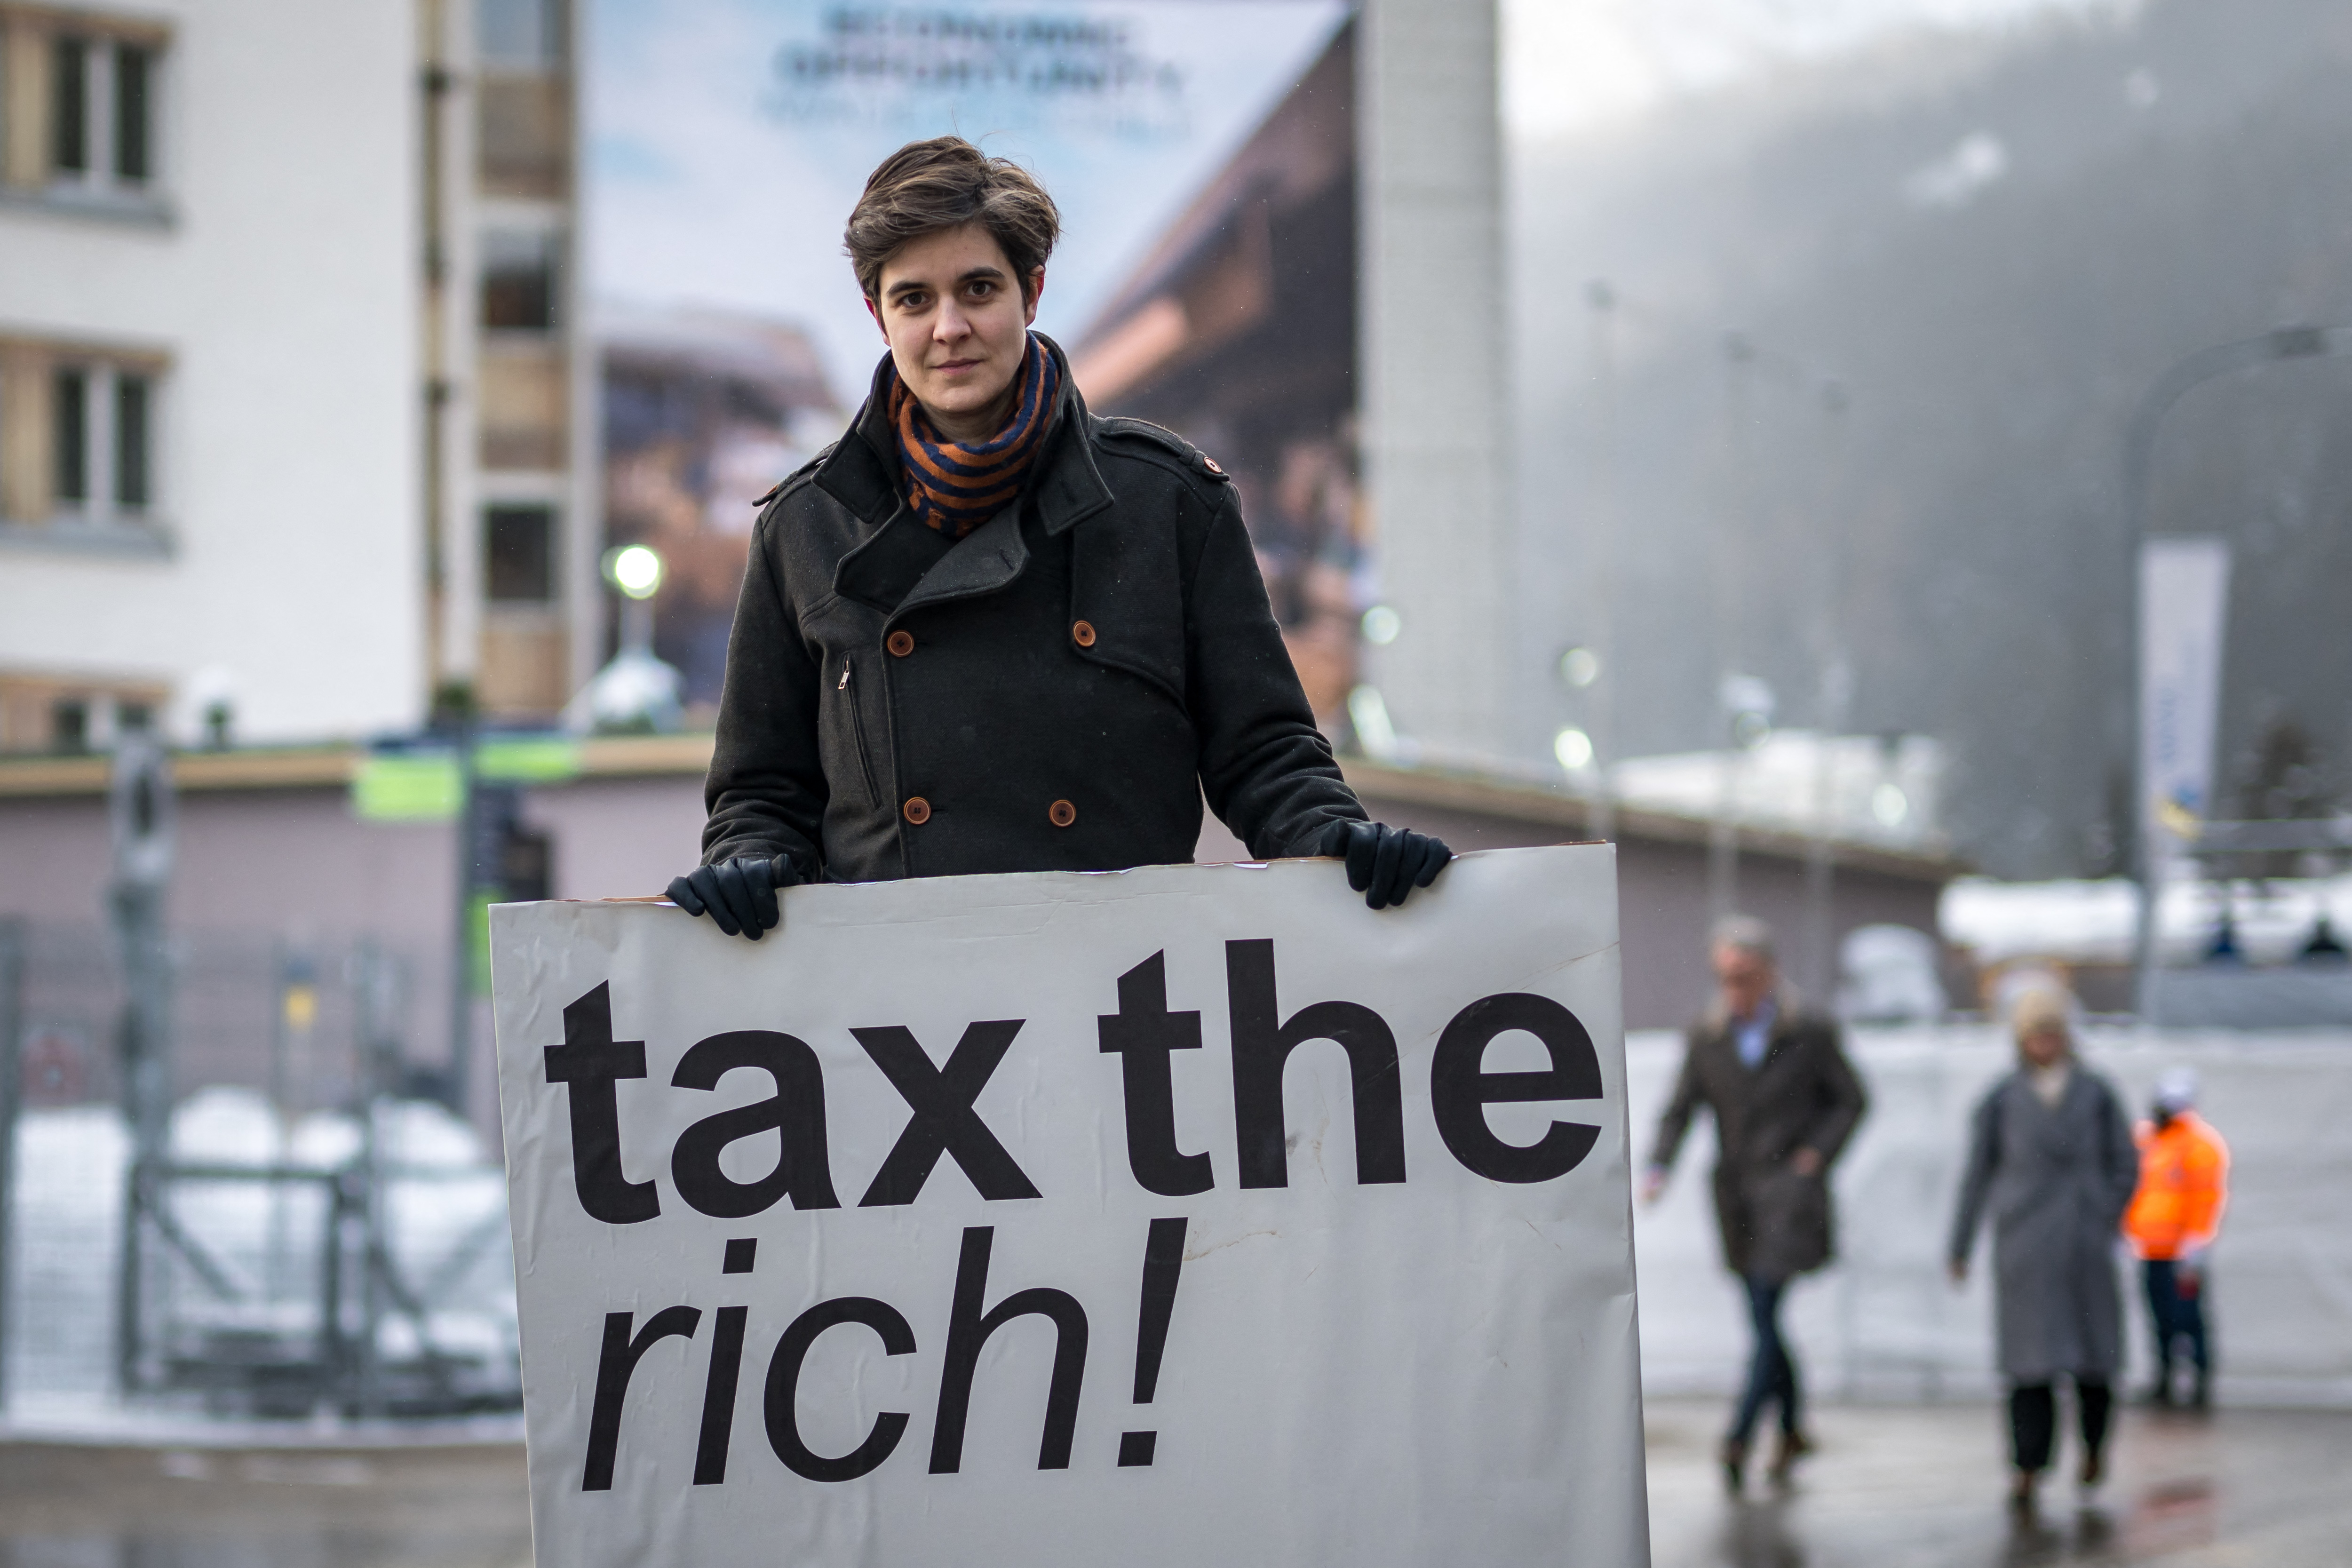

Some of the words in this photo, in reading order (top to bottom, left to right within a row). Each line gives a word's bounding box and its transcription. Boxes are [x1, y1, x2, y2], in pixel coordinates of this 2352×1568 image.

[543, 979, 1044, 1225] tax
[1097, 938, 1604, 1197] the
[581, 1217, 1189, 1492] rich!
